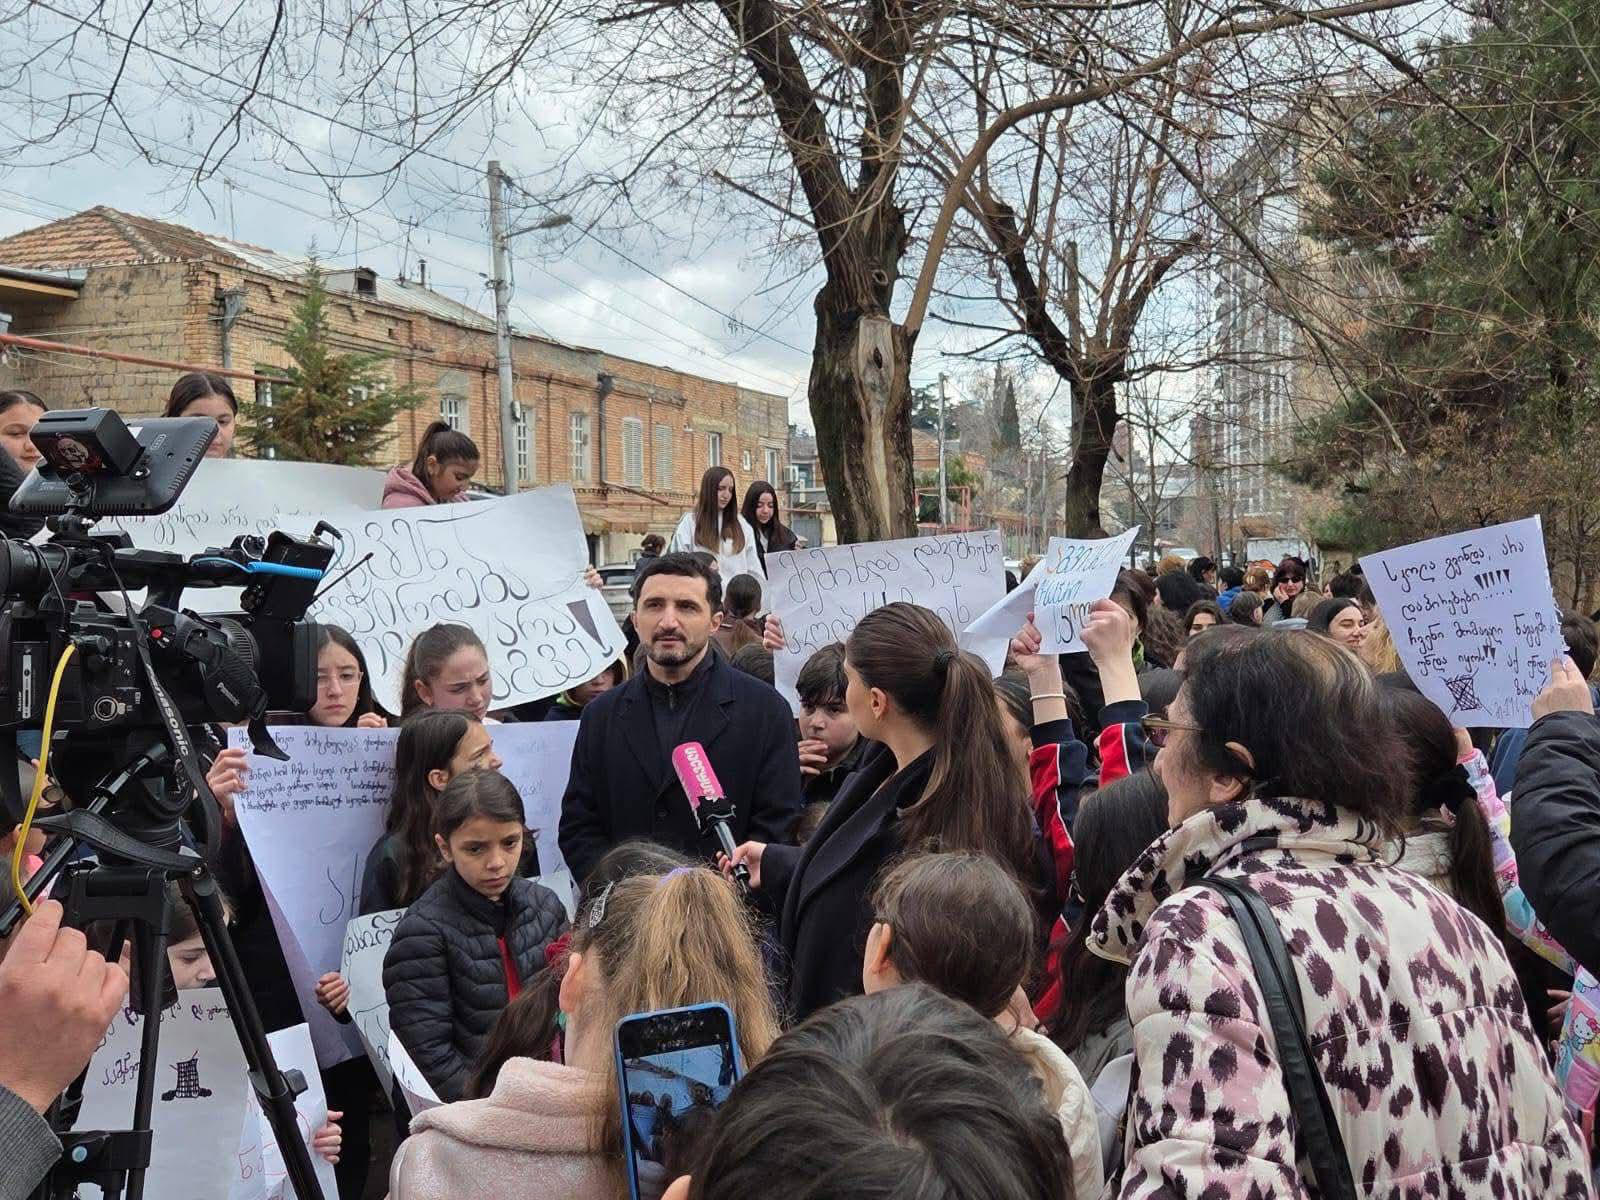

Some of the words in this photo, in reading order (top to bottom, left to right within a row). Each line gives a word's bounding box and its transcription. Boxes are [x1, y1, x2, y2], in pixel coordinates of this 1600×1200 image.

[1382, 560, 1436, 593] სკოლა
[1502, 534, 1525, 556] არა
[1408, 623, 1445, 655] ჩვენი
[1417, 653, 1448, 677] უნდა
